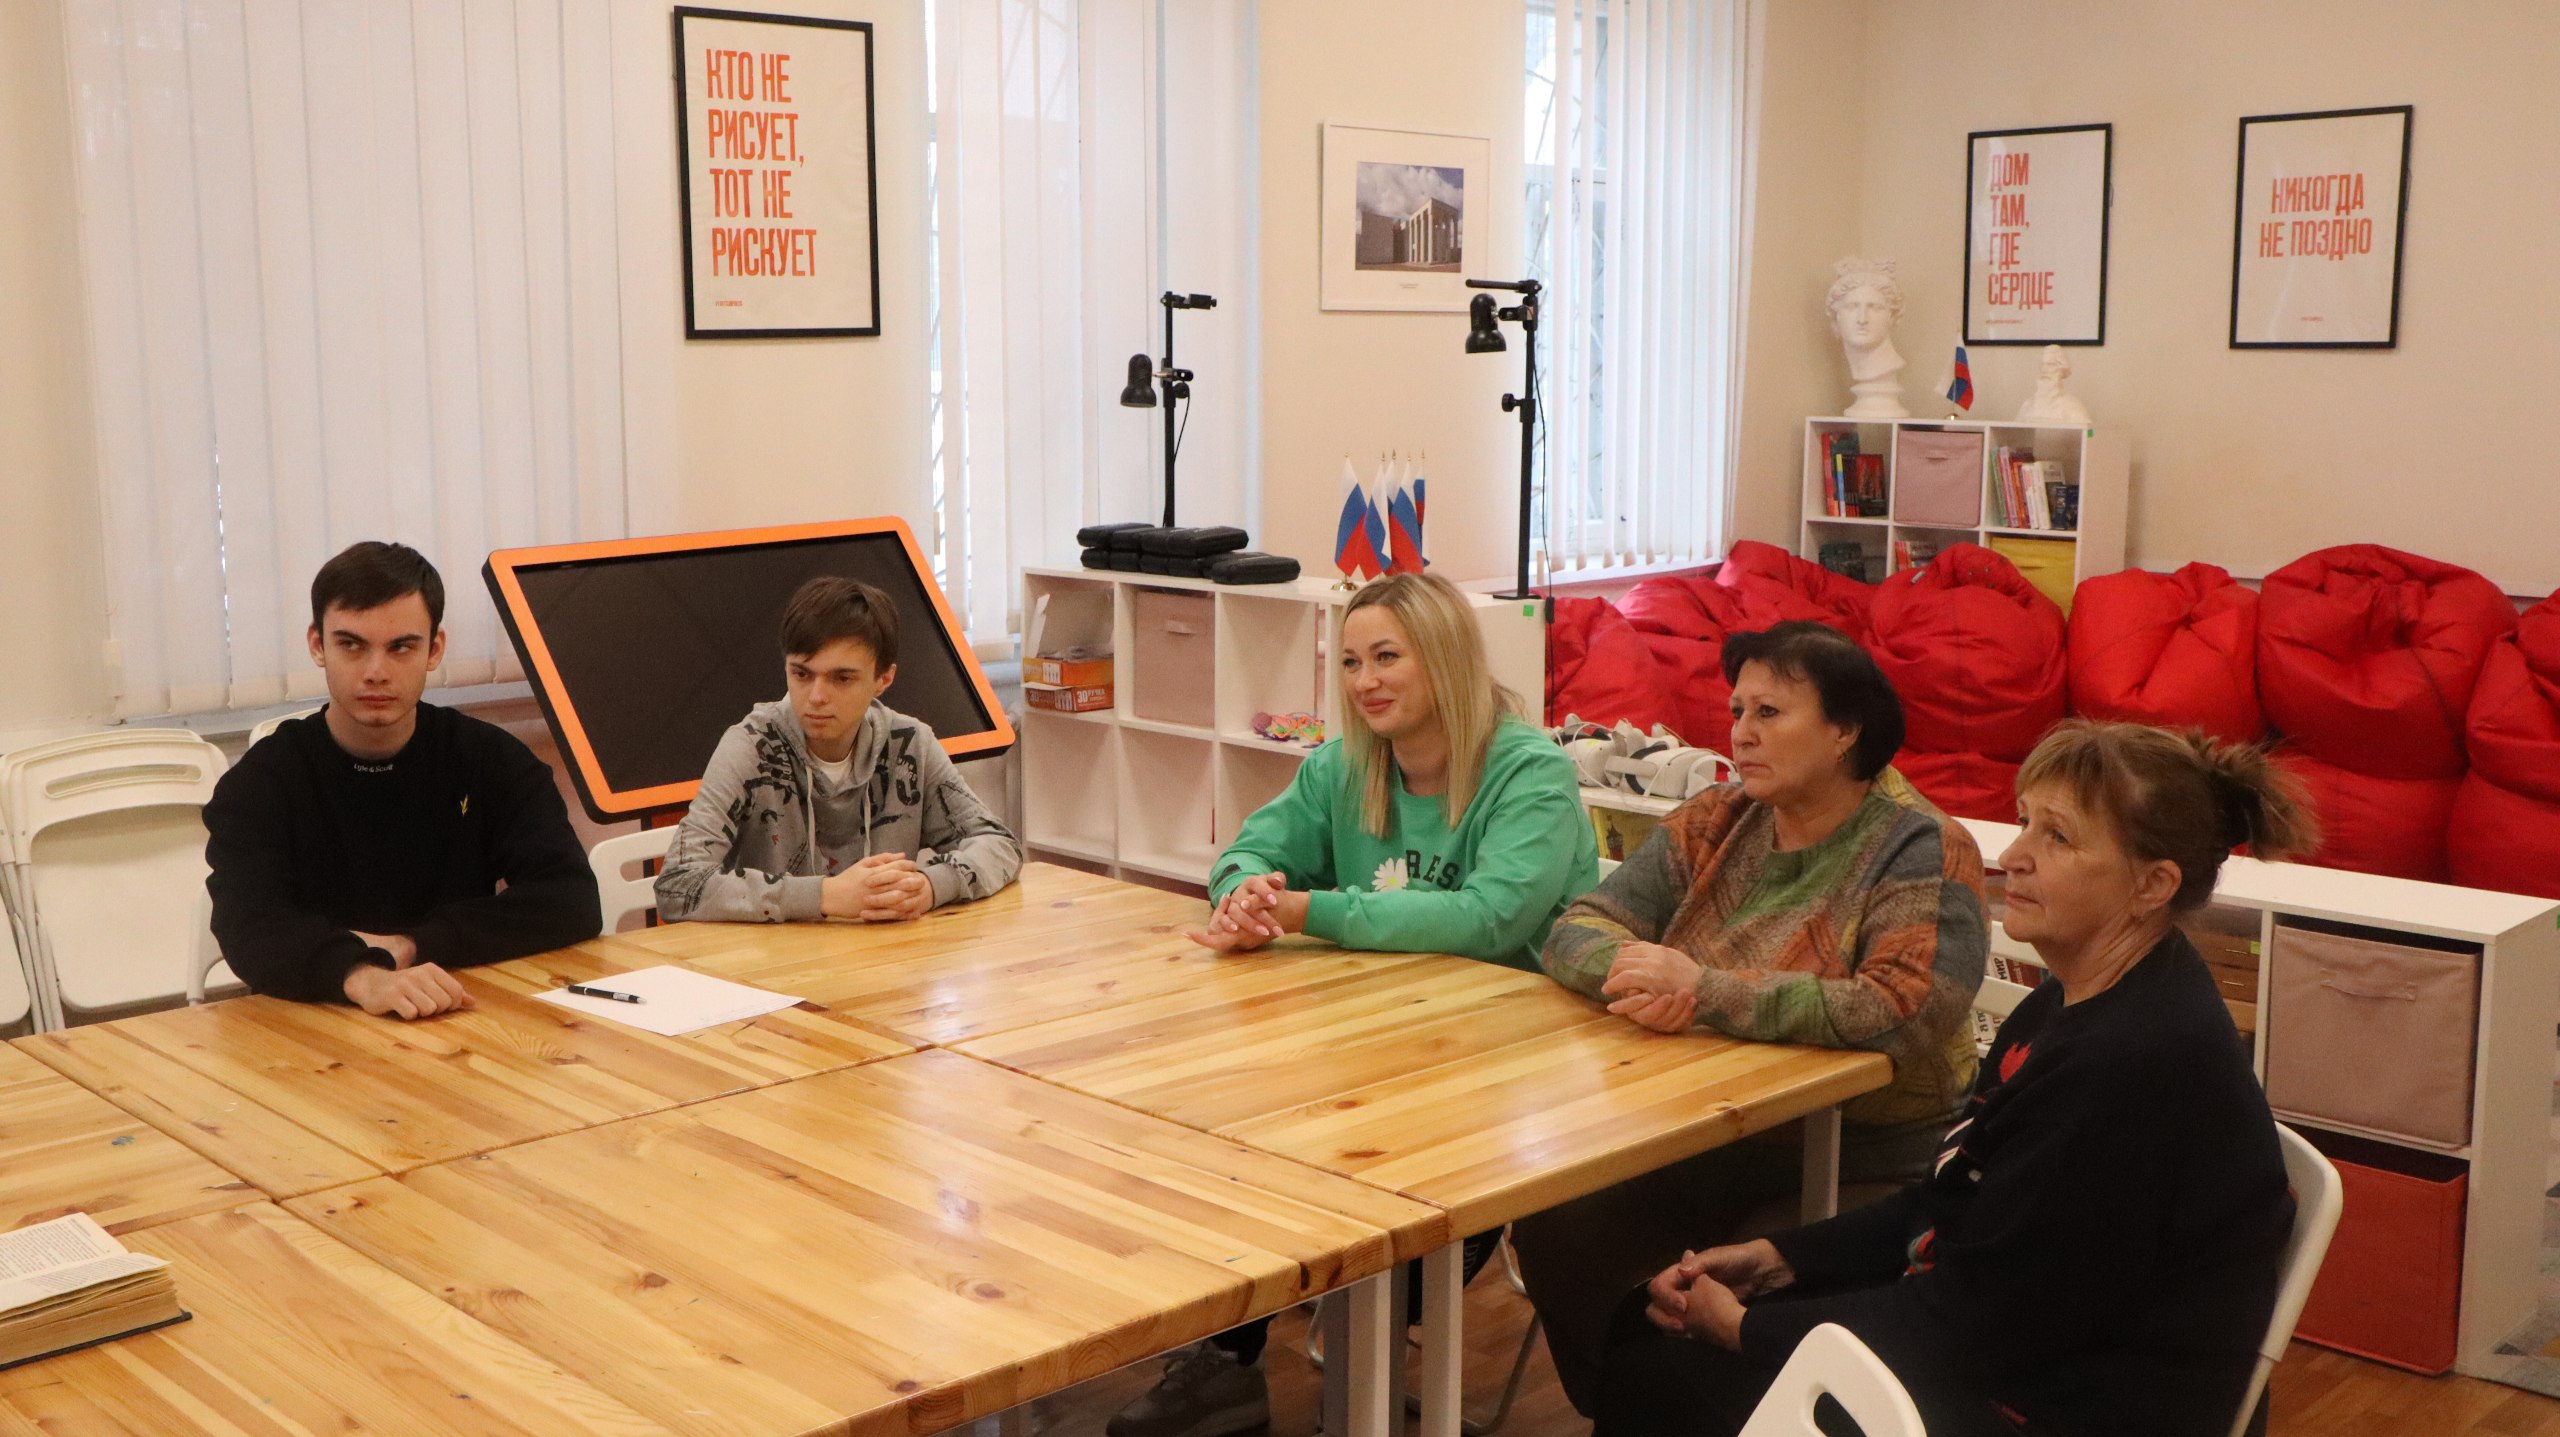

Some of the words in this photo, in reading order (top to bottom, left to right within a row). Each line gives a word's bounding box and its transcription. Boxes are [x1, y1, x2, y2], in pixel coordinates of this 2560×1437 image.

[706, 48, 754, 101] КТО
[761, 53, 793, 103] НЕ
[707, 109, 805, 168] РИСУЕТ,
[709, 168, 753, 219] ТОТ
[762, 170, 793, 219] НЕ
[1990, 152, 2030, 192] ДОМ
[2271, 172, 2365, 217] НИКОГДА
[1990, 193, 2030, 230] ТАМ,
[711, 227, 817, 277] РИСКУЕТ
[1989, 231, 2022, 271] ГДЕ
[2259, 221, 2286, 258] НЕ
[2290, 217, 2373, 262] ПОЗДНО
[1988, 271, 2055, 311] СЕРДЦЕ
